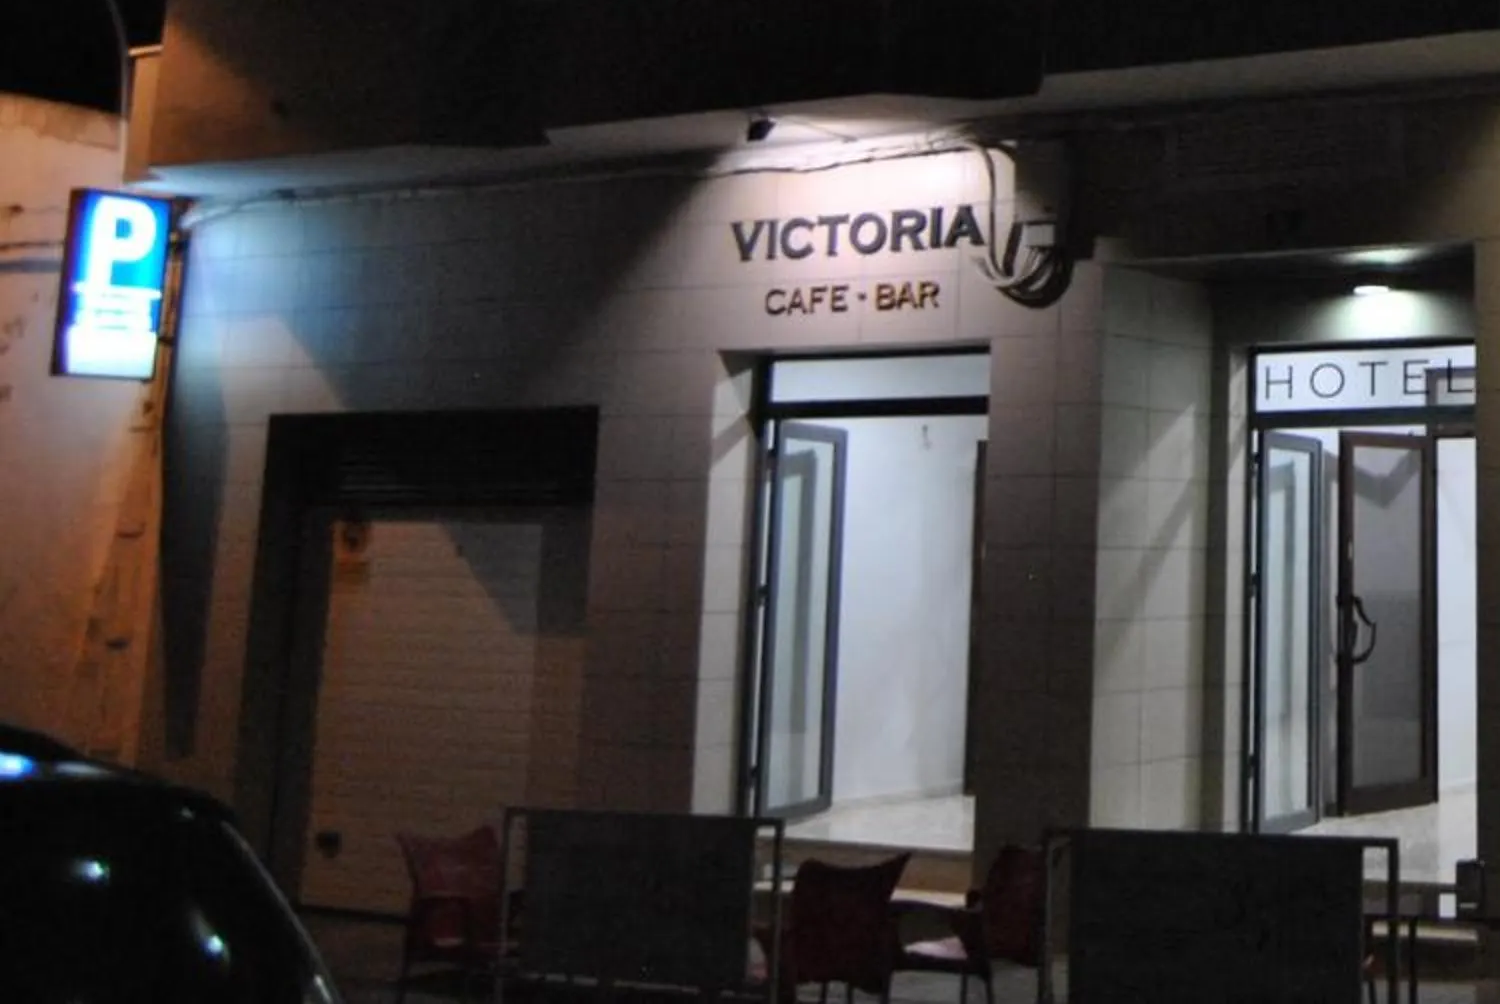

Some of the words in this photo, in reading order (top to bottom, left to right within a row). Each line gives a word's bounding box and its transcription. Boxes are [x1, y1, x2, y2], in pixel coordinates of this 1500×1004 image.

[84, 195, 157, 287] P
[730, 204, 985, 263] VICTORIA
[765, 284, 849, 316] CAFE
[875, 281, 941, 311] BAR
[1264, 358, 1476, 400] HOTEL
